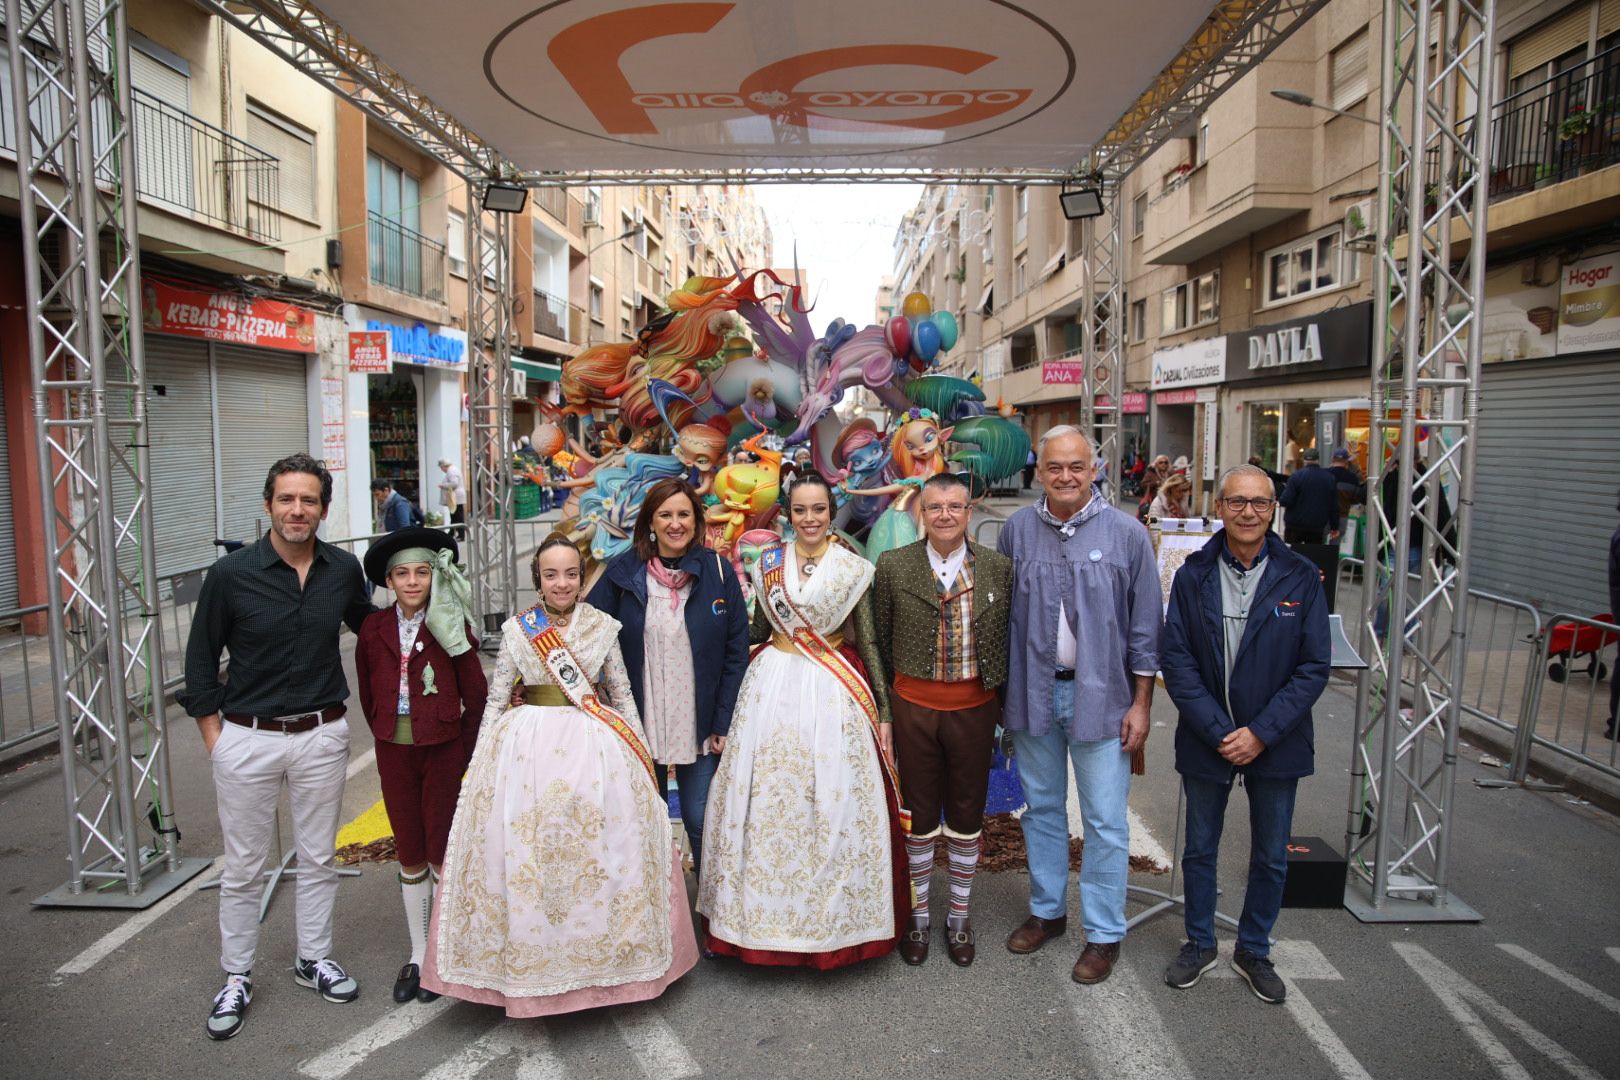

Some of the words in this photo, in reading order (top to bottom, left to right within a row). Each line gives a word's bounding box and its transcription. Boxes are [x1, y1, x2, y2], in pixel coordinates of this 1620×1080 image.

[1569, 265, 1613, 288] Hogar
[166, 302, 287, 339] KEBAB-PIZZERIA
[429, 334, 464, 363] SHOP
[1248, 323, 1323, 370] DAYLA
[1044, 371, 1073, 381] ANA
